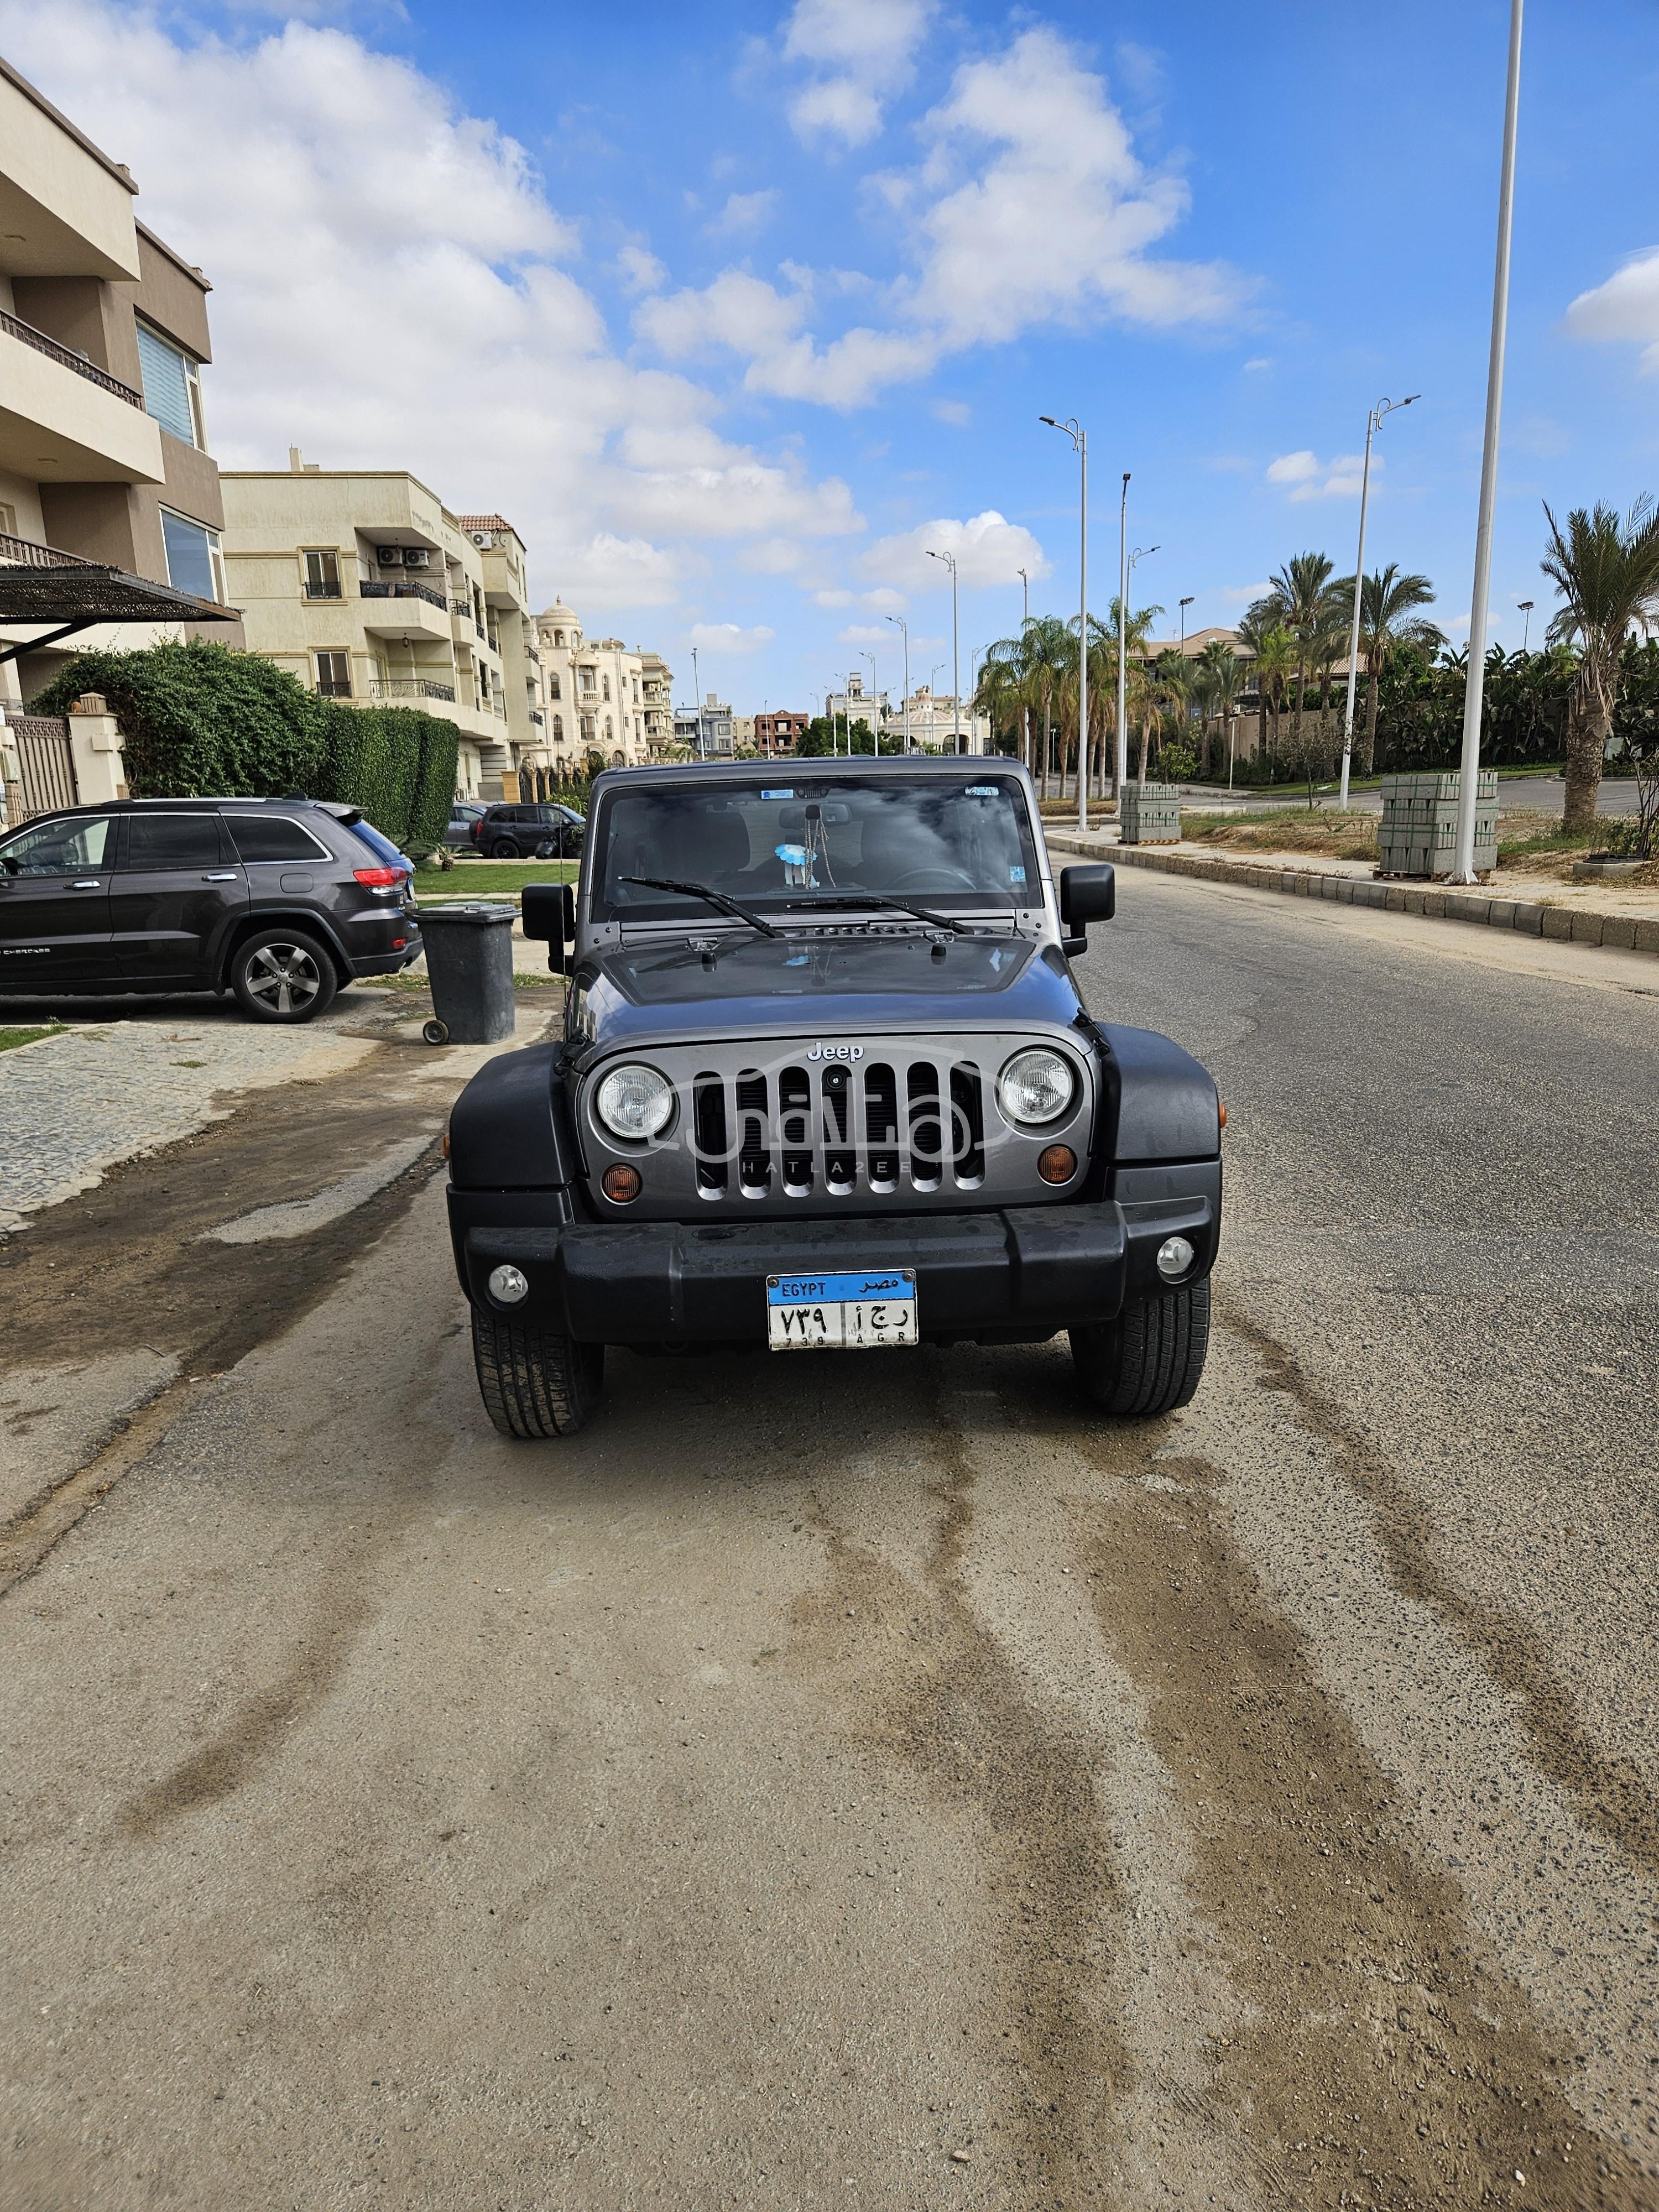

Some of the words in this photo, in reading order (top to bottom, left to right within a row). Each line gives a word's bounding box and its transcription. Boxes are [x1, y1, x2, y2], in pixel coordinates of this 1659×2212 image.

[807, 1042, 864, 1063] Jeep
[781, 1281, 826, 1297] EGYPT
[858, 1278, 899, 1293] مصر
